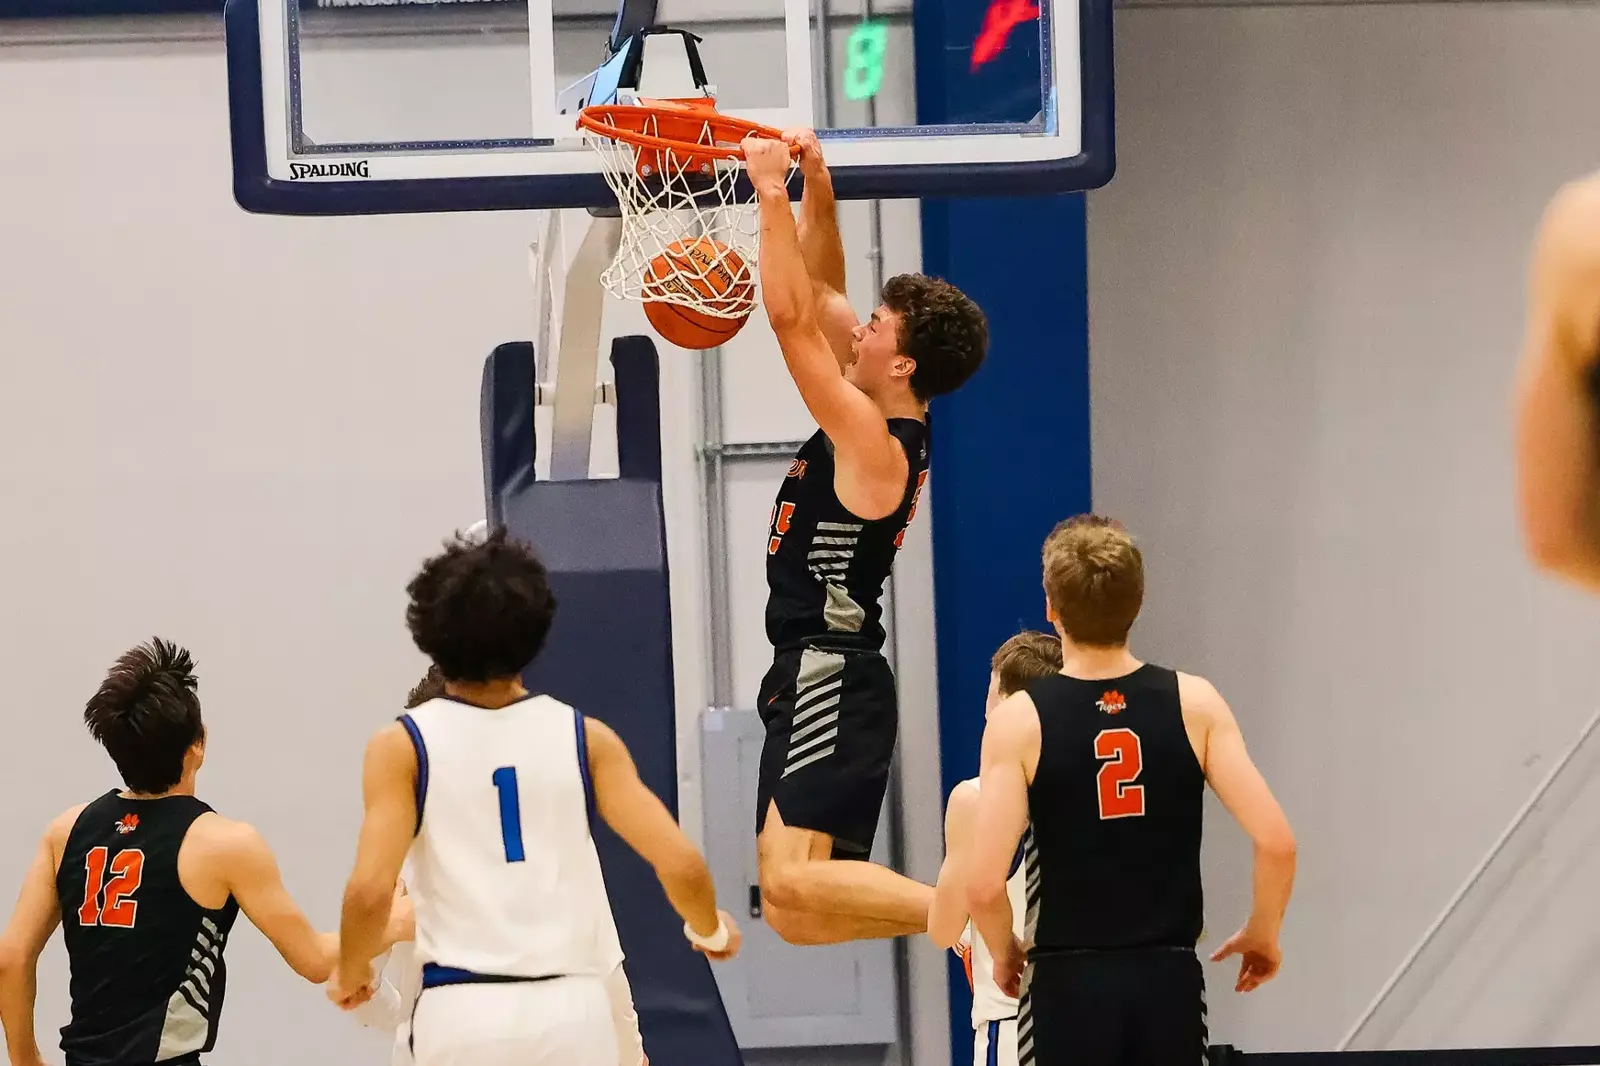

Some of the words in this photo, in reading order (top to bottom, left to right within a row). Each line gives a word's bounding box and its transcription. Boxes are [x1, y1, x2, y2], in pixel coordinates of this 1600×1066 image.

[289, 160, 369, 181] SPALDING
[1095, 700, 1127, 714] Tigers
[492, 765, 525, 863] 1
[1093, 727, 1145, 820] 2
[78, 846, 145, 929] 12
